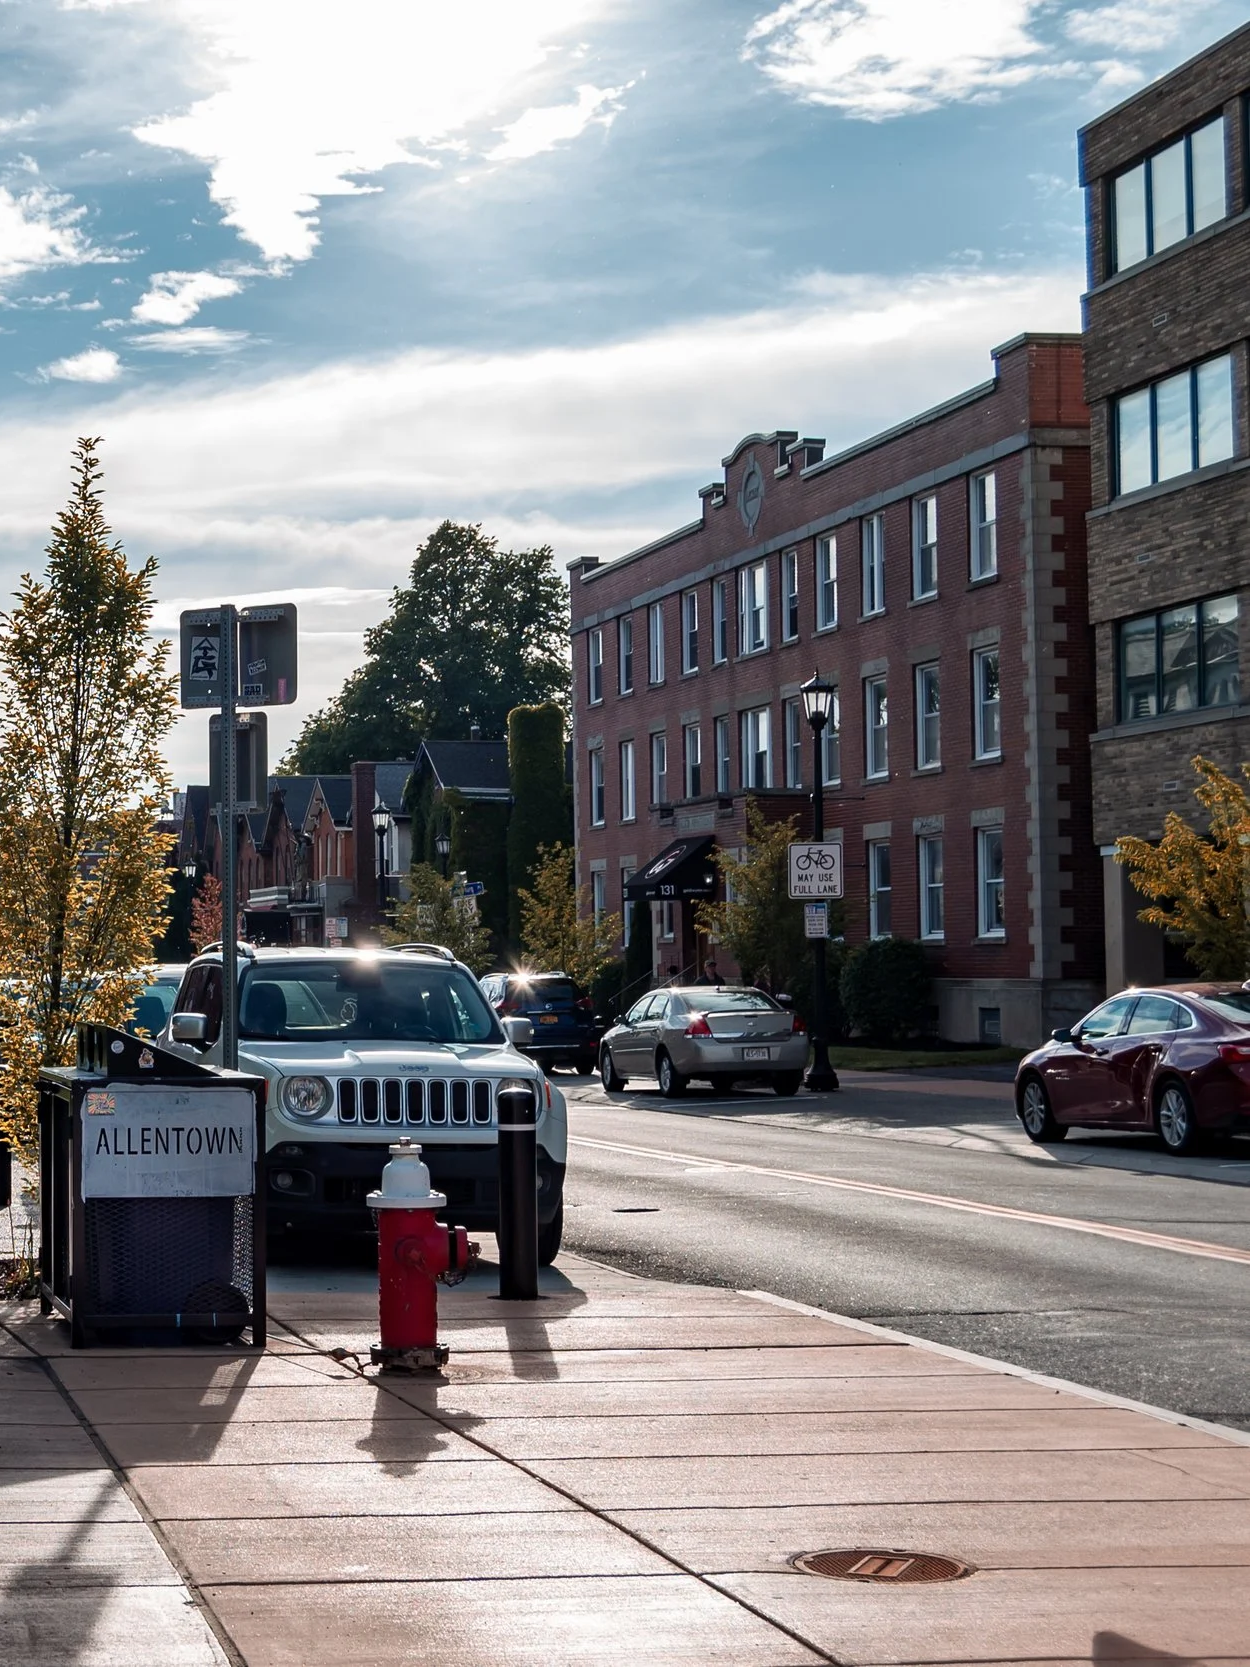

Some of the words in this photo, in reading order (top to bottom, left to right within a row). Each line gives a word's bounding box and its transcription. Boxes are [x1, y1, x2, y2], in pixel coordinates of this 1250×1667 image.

[797, 873, 815, 882] MAY
[818, 873, 834, 882] USE
[660, 885, 675, 896] 131
[793, 885, 813, 894] FULL
[818, 885, 838, 894] LANE
[398, 1064, 430, 1074] Jeep
[95, 1126, 243, 1156] ALLENTOWN
